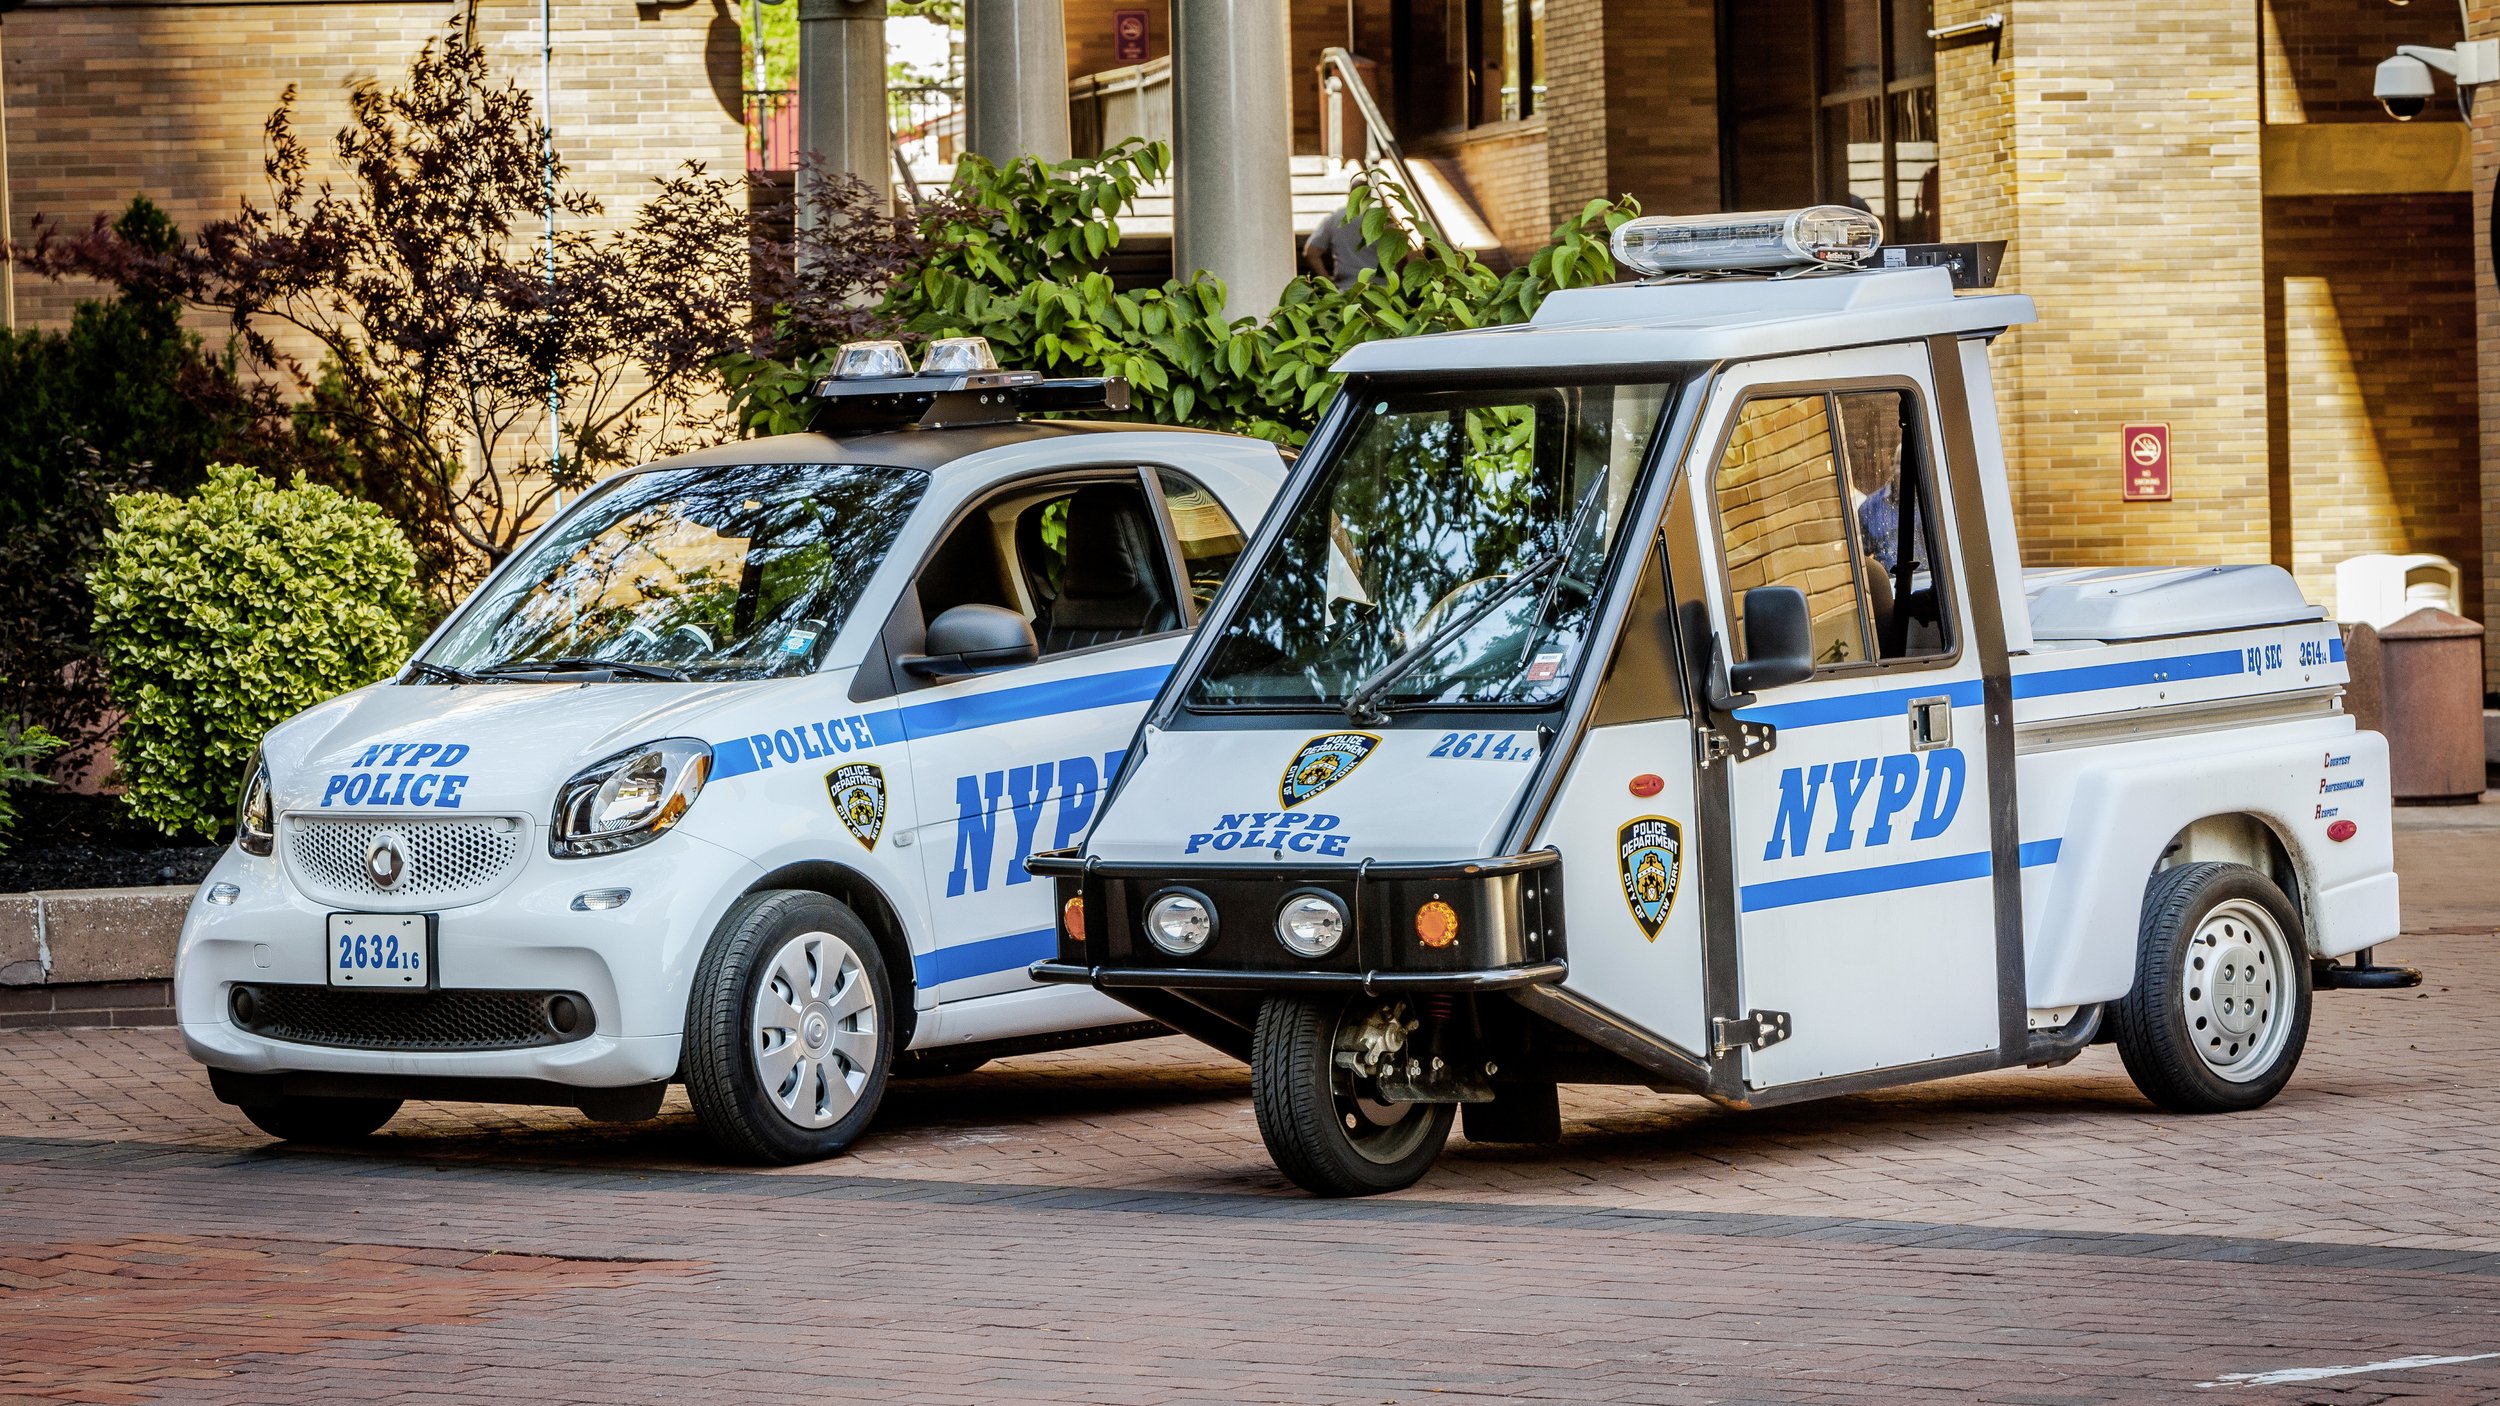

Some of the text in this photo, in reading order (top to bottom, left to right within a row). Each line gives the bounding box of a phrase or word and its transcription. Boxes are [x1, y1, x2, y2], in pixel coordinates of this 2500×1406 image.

[2247, 646, 2262, 676] HQ
[2265, 644, 2282, 670] SEC
[2300, 641, 2322, 667] 2614
[750, 715, 873, 769] POLICE
[1300, 743, 1368, 757] DEPARTMENT
[1324, 735, 1366, 746] POLICE
[1430, 733, 1516, 759] 2614
[351, 743, 470, 768] NYPD
[831, 775, 882, 797] DEPARTMENT
[837, 765, 870, 780] POLICE
[1283, 765, 1298, 795] CITY OF
[1302, 761, 1358, 800] NEW YORK
[320, 773, 469, 808] POLICE
[1763, 747, 1966, 861] NYPD
[836, 804, 862, 838] CITY OF
[871, 820, 881, 840] NEW
[946, 749, 1127, 898] NYP
[1213, 812, 1341, 831] NYPD
[1633, 821, 1667, 837] POLICE
[1185, 830, 1350, 857] POLICE
[1622, 834, 1678, 859] DEPARTMENT
[1624, 872, 1646, 919] CITY OF
[1656, 861, 1679, 924] NEW YORK
[339, 934, 399, 969] 2632
